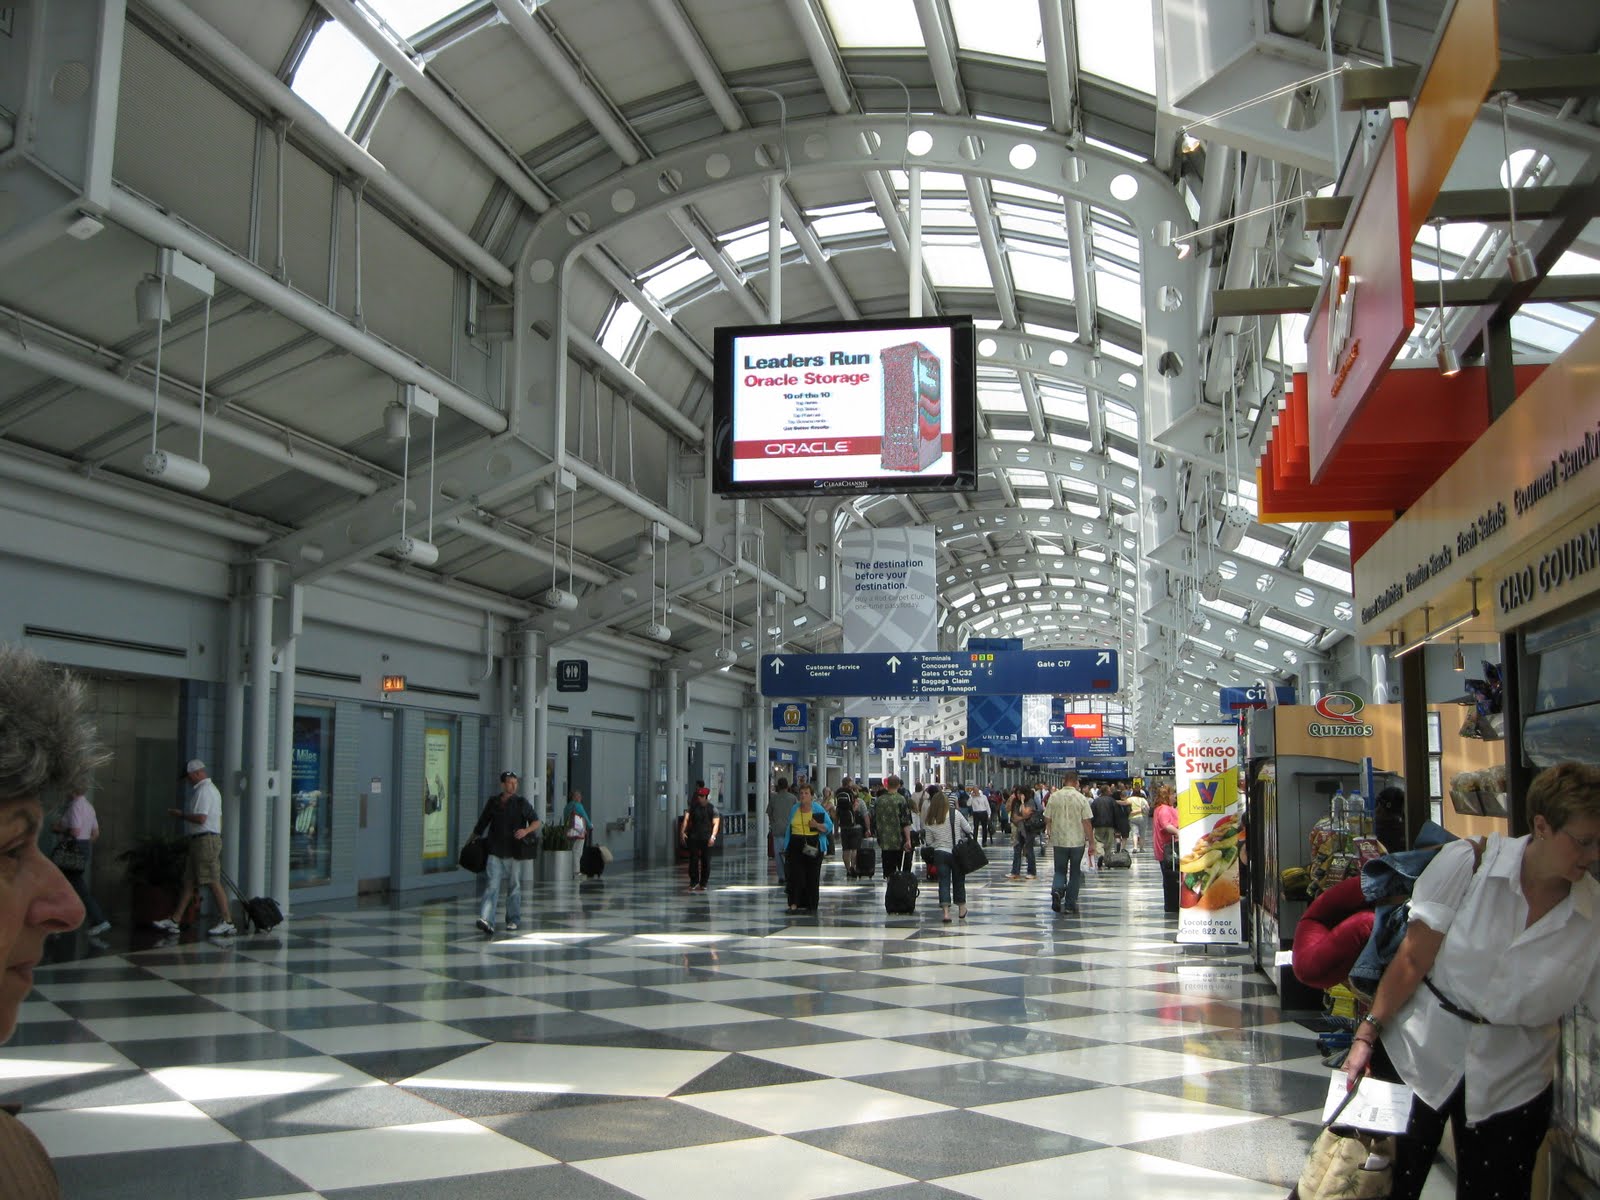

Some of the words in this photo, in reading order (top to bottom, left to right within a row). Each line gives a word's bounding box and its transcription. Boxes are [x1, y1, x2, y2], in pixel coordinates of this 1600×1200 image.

[744, 354, 824, 370] Leaders
[830, 351, 870, 366] Run
[744, 374, 798, 387] Oracle
[804, 372, 870, 386] Storage
[764, 441, 849, 455] ORACLE
[1514, 460, 1557, 518] Gourmet
[1457, 523, 1477, 557] Fresh
[1478, 501, 1506, 541] Salads
[855, 561, 871, 570] The
[873, 560, 923, 569] destination
[1499, 566, 1534, 613] CIAO
[1538, 523, 1600, 593] GOURM
[855, 572, 884, 580] before
[886, 572, 907, 581] your
[855, 582, 908, 591] destination.
[888, 594, 909, 602] Carpet
[383, 676, 404, 689] EXIT
[1050, 724, 1057, 732] B
[297, 749, 317, 762] Miles
[1177, 743, 1235, 757] CHICAGO
[1185, 758, 1228, 773] STYLE!
